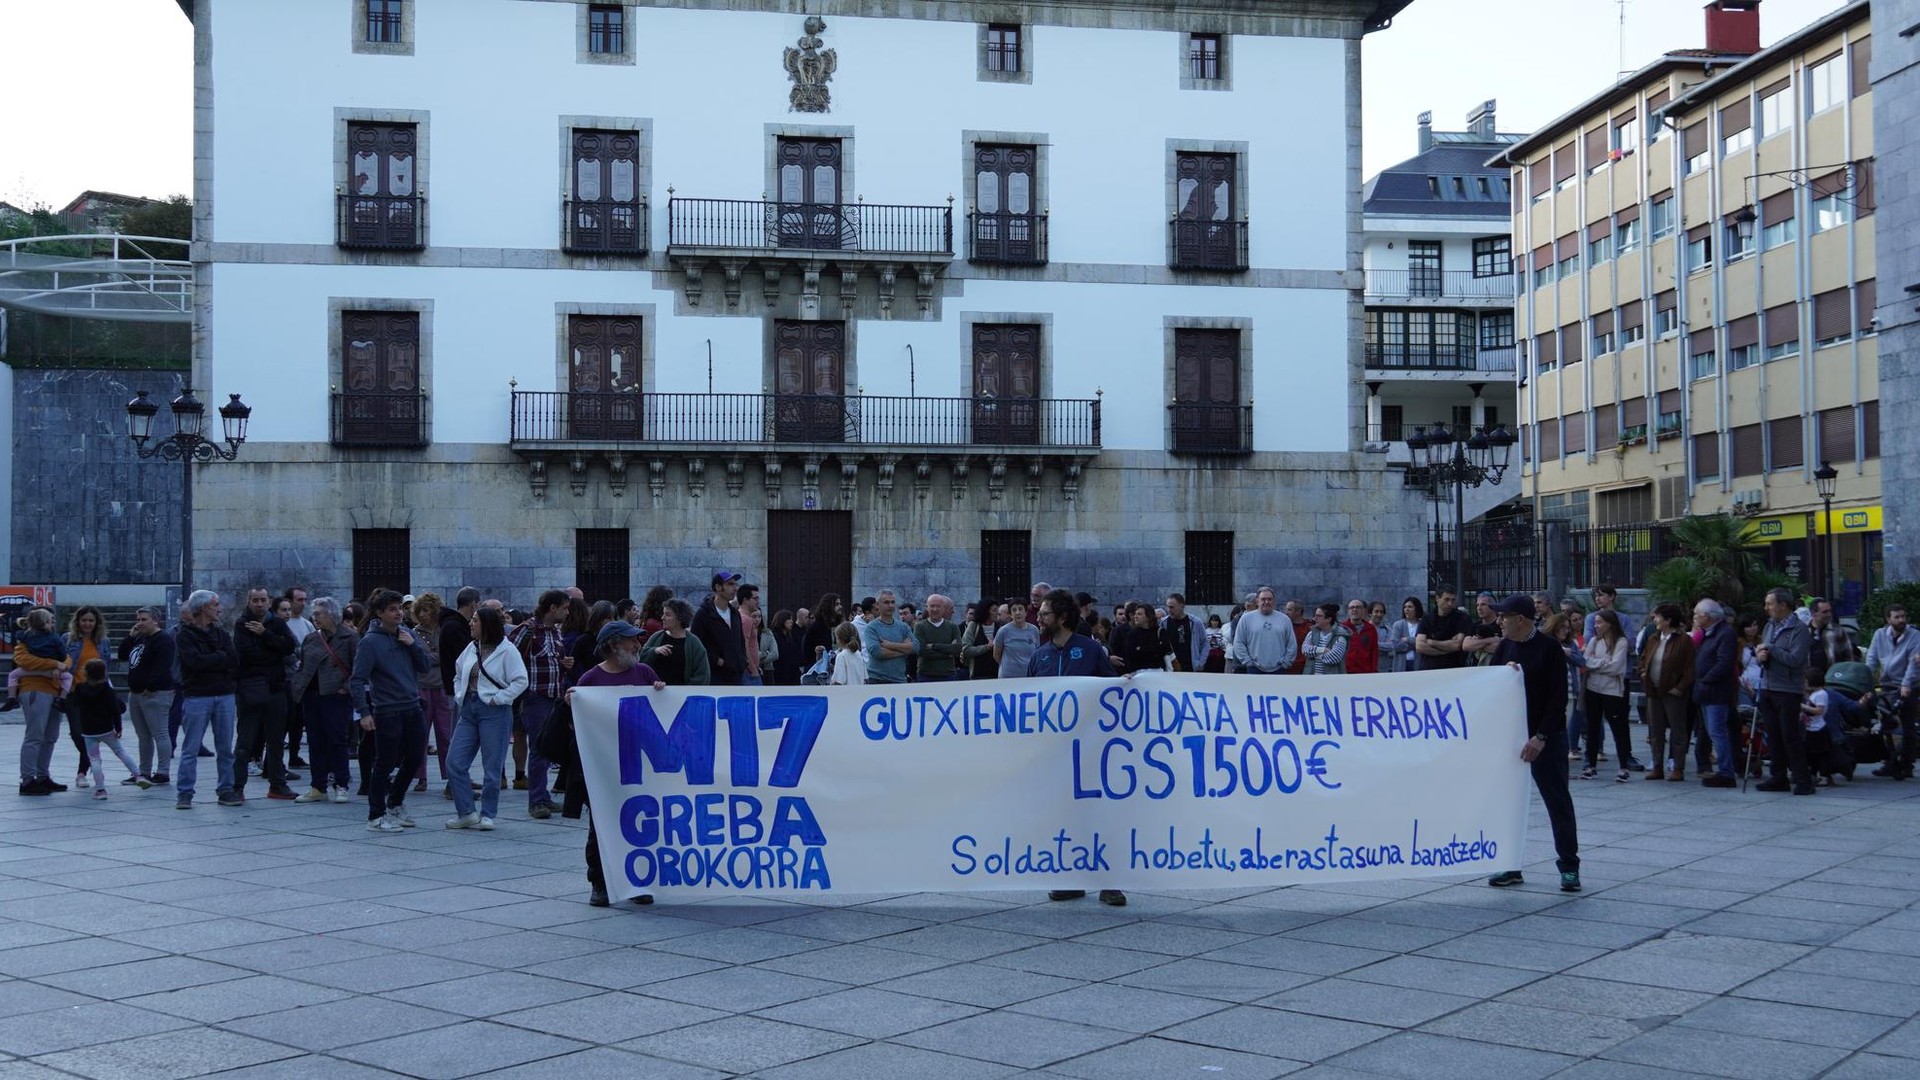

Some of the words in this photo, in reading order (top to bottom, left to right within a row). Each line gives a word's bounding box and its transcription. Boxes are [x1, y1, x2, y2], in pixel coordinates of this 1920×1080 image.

[860, 690, 1078, 740] GUTXIENEKO
[1098, 686, 1237, 735] SOLDATA
[1247, 695, 1343, 736] HEMEN
[1350, 696, 1468, 740] ERABAKI
[619, 696, 828, 787] M17
[1073, 737, 1175, 800] LGS
[620, 794, 827, 846] GREBA
[951, 829, 1110, 876] Soldatak
[1411, 819, 1497, 866] banatzeko
[624, 847, 832, 889] OROKORRA
